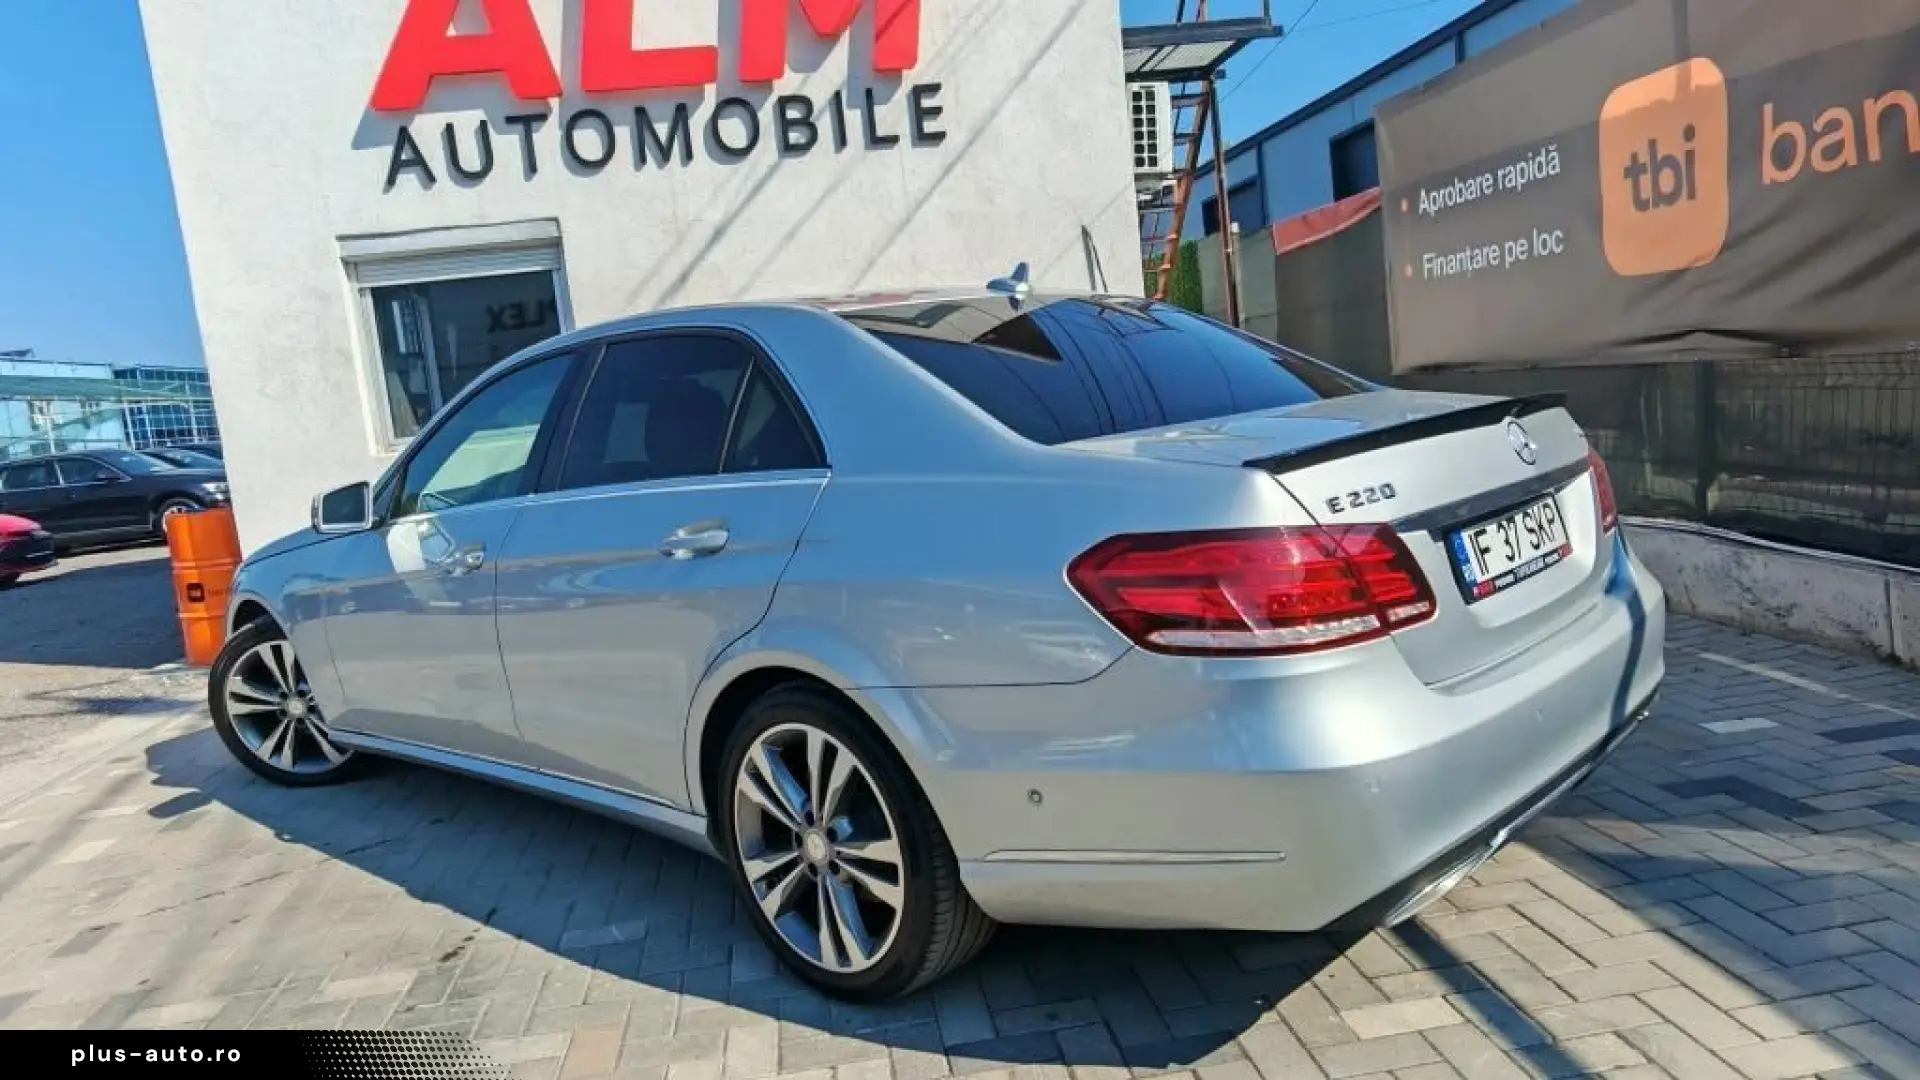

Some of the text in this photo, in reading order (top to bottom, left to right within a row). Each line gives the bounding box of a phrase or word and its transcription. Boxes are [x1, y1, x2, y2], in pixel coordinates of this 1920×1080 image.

[371, 0, 922, 111] ALM
[384, 83, 947, 192] AUTOMOBILE
[1623, 124, 1696, 212] tbi
[1418, 143, 1561, 217] Aprobare rapidă
[1504, 237, 1529, 268] pe
[1532, 226, 1564, 257] loc
[1326, 483, 1397, 514] E 220
[1468, 529, 1491, 576] IF
[1497, 516, 1522, 562] 37
